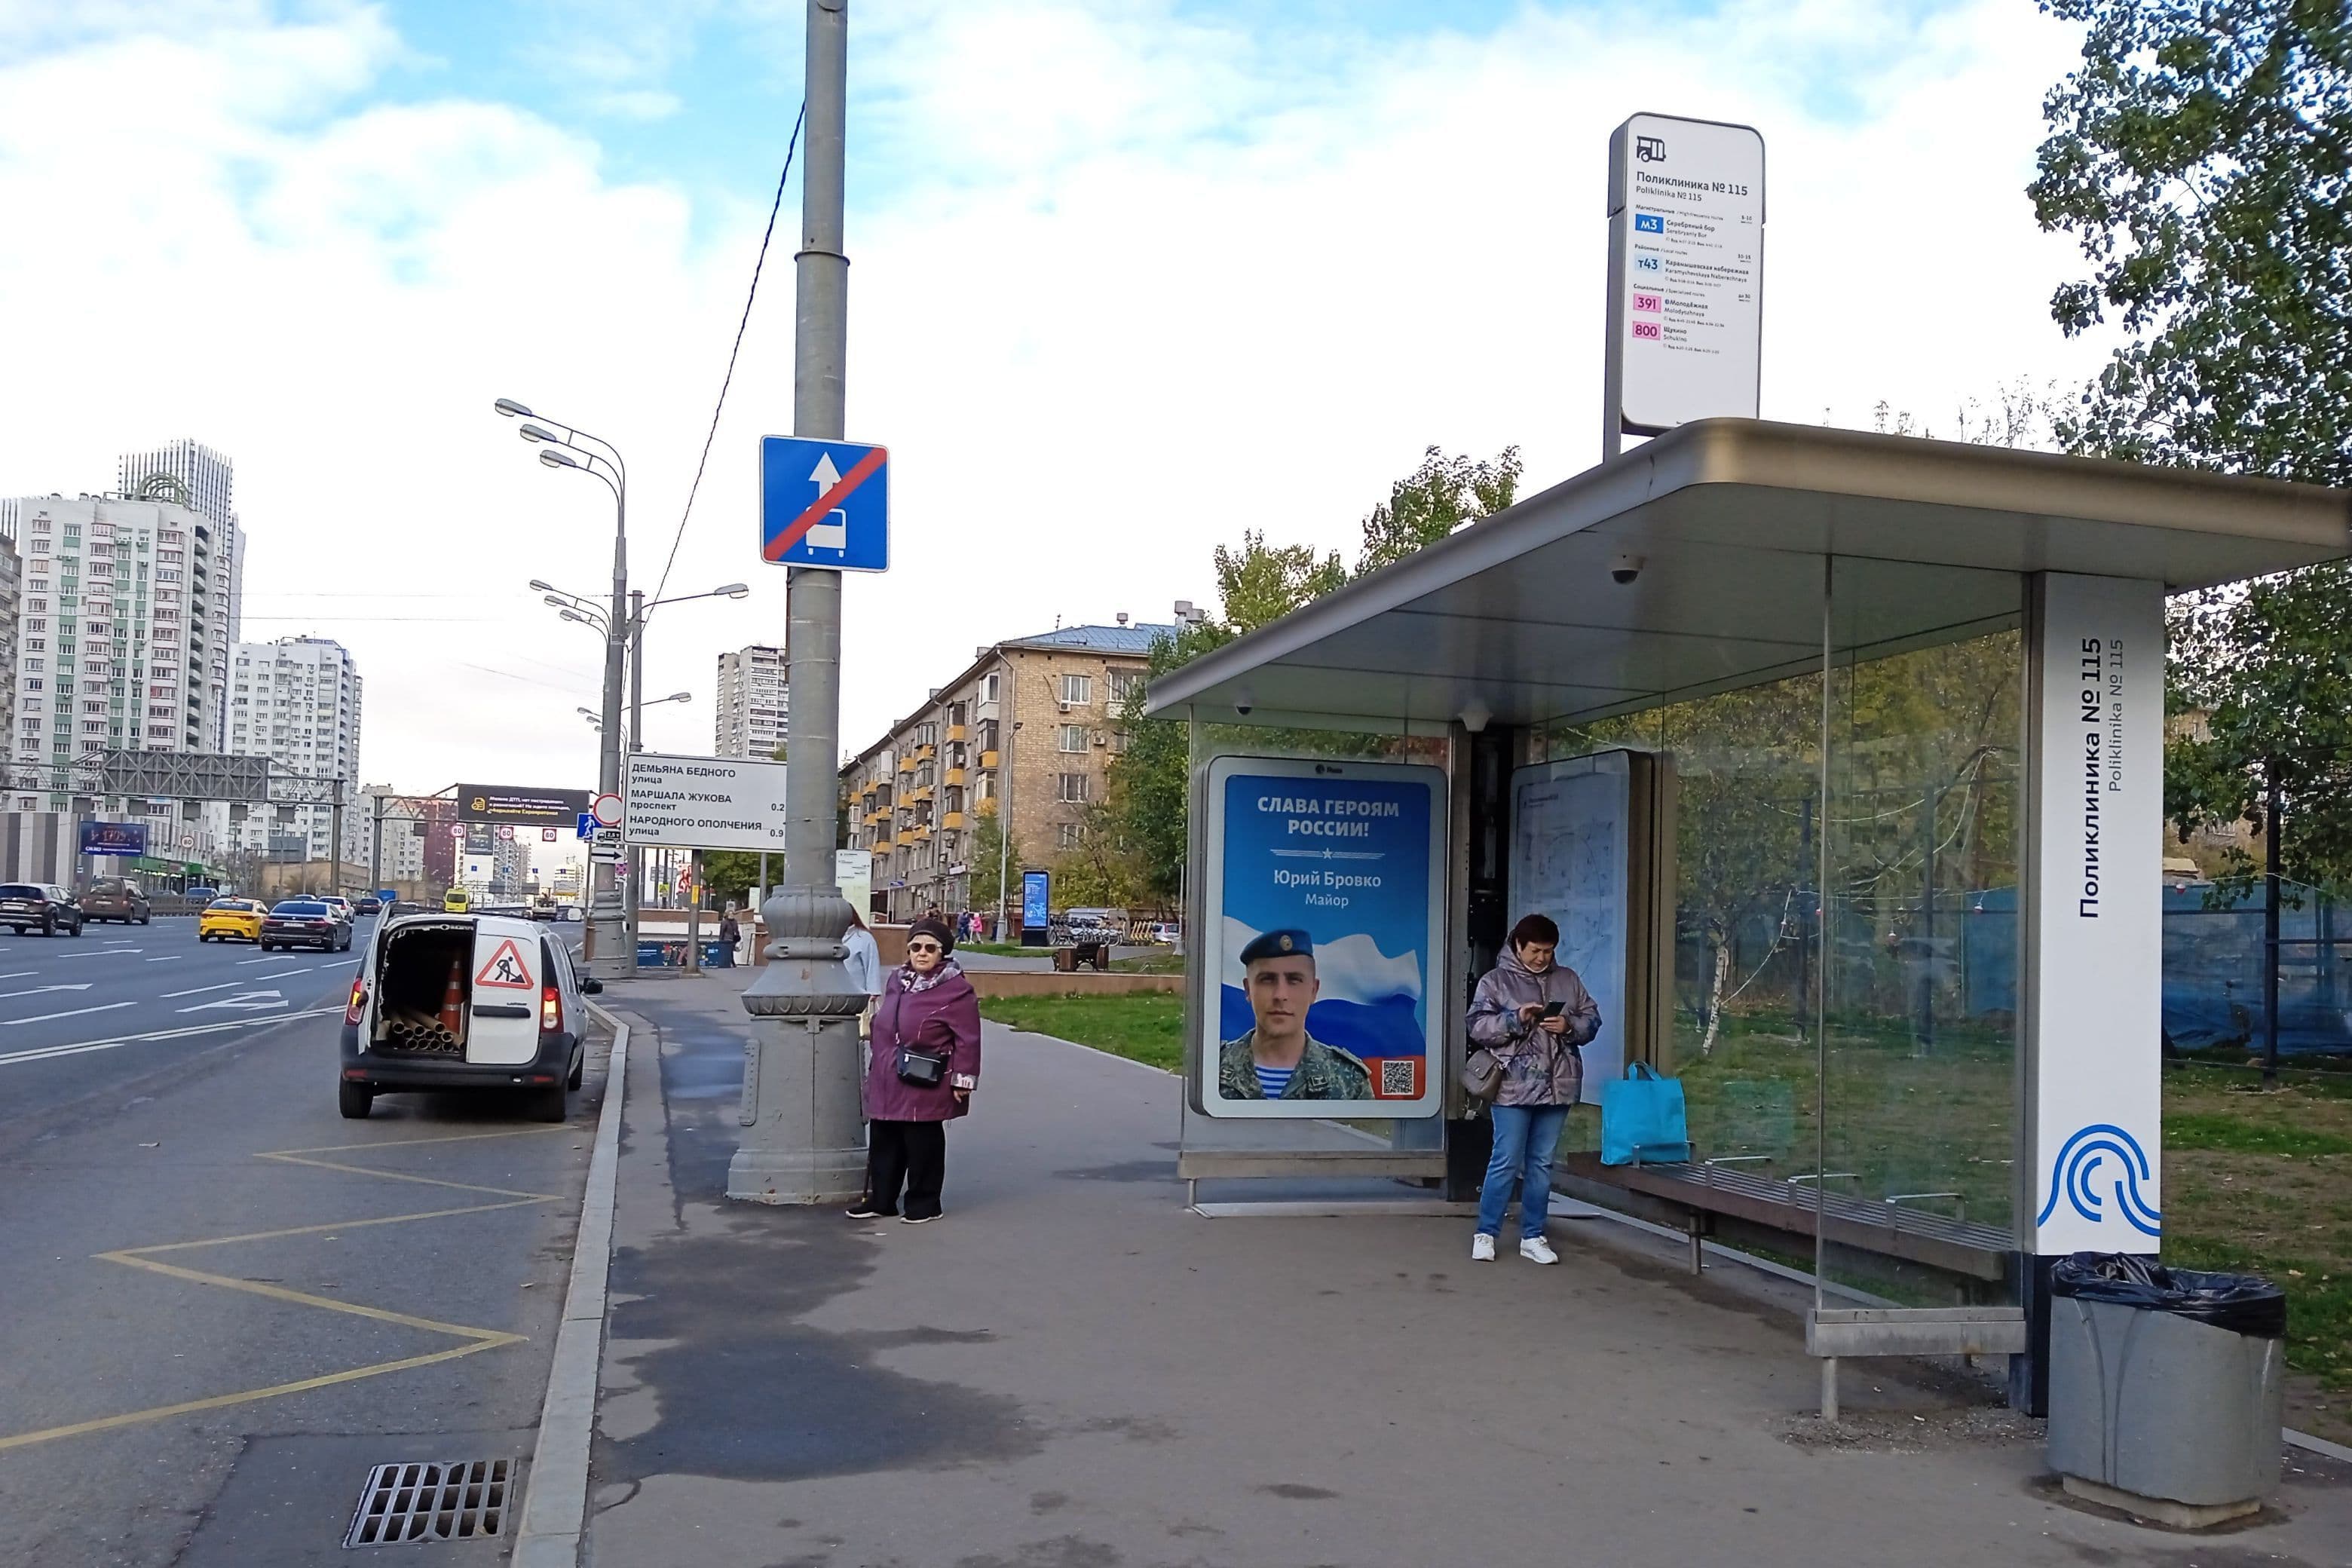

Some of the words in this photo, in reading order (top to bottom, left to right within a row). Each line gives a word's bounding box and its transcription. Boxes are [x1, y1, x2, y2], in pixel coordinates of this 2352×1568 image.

[1637, 171, 1709, 191] Поликлиника
[1712, 182, 1725, 193] №
[1728, 184, 1748, 196] 115
[1636, 185, 1675, 198] Poliklinika
[1677, 191, 1687, 199] №
[1689, 192, 1702, 201] 115
[1638, 297, 1656, 310] 391
[1635, 324, 1658, 337] 800
[2081, 638, 2101, 682] 115
[2110, 639, 2124, 669] 115
[2109, 674, 2123, 696] №
[2081, 690, 2100, 722] №
[2109, 702, 2123, 792] Poliklinika
[632, 763, 684, 775] ДЕМЬЯНА
[687, 767, 736, 778] БЕДНОГО
[632, 775, 663, 785] улица
[631, 789, 685, 801] МАРШАЛА
[688, 793, 732, 804] ЖУКОВА
[630, 801, 677, 811] проспект
[771, 803, 785, 812] 0.2
[1257, 796, 1320, 814] СЛАВА
[1325, 799, 1399, 817] ГЕРОЯМ
[629, 815, 695, 828] НАРОДНОГО
[697, 819, 762, 831] ОПОЛЧЕНИЯ
[629, 826, 660, 836] улица
[1288, 819, 1369, 838] РОССИИ!
[2080, 732, 2100, 918] Поликлиника
[770, 828, 784, 838] 0.9
[1274, 869, 1320, 888] Юрий
[1325, 871, 1382, 890] Бровко
[1306, 893, 1349, 909] Майор
